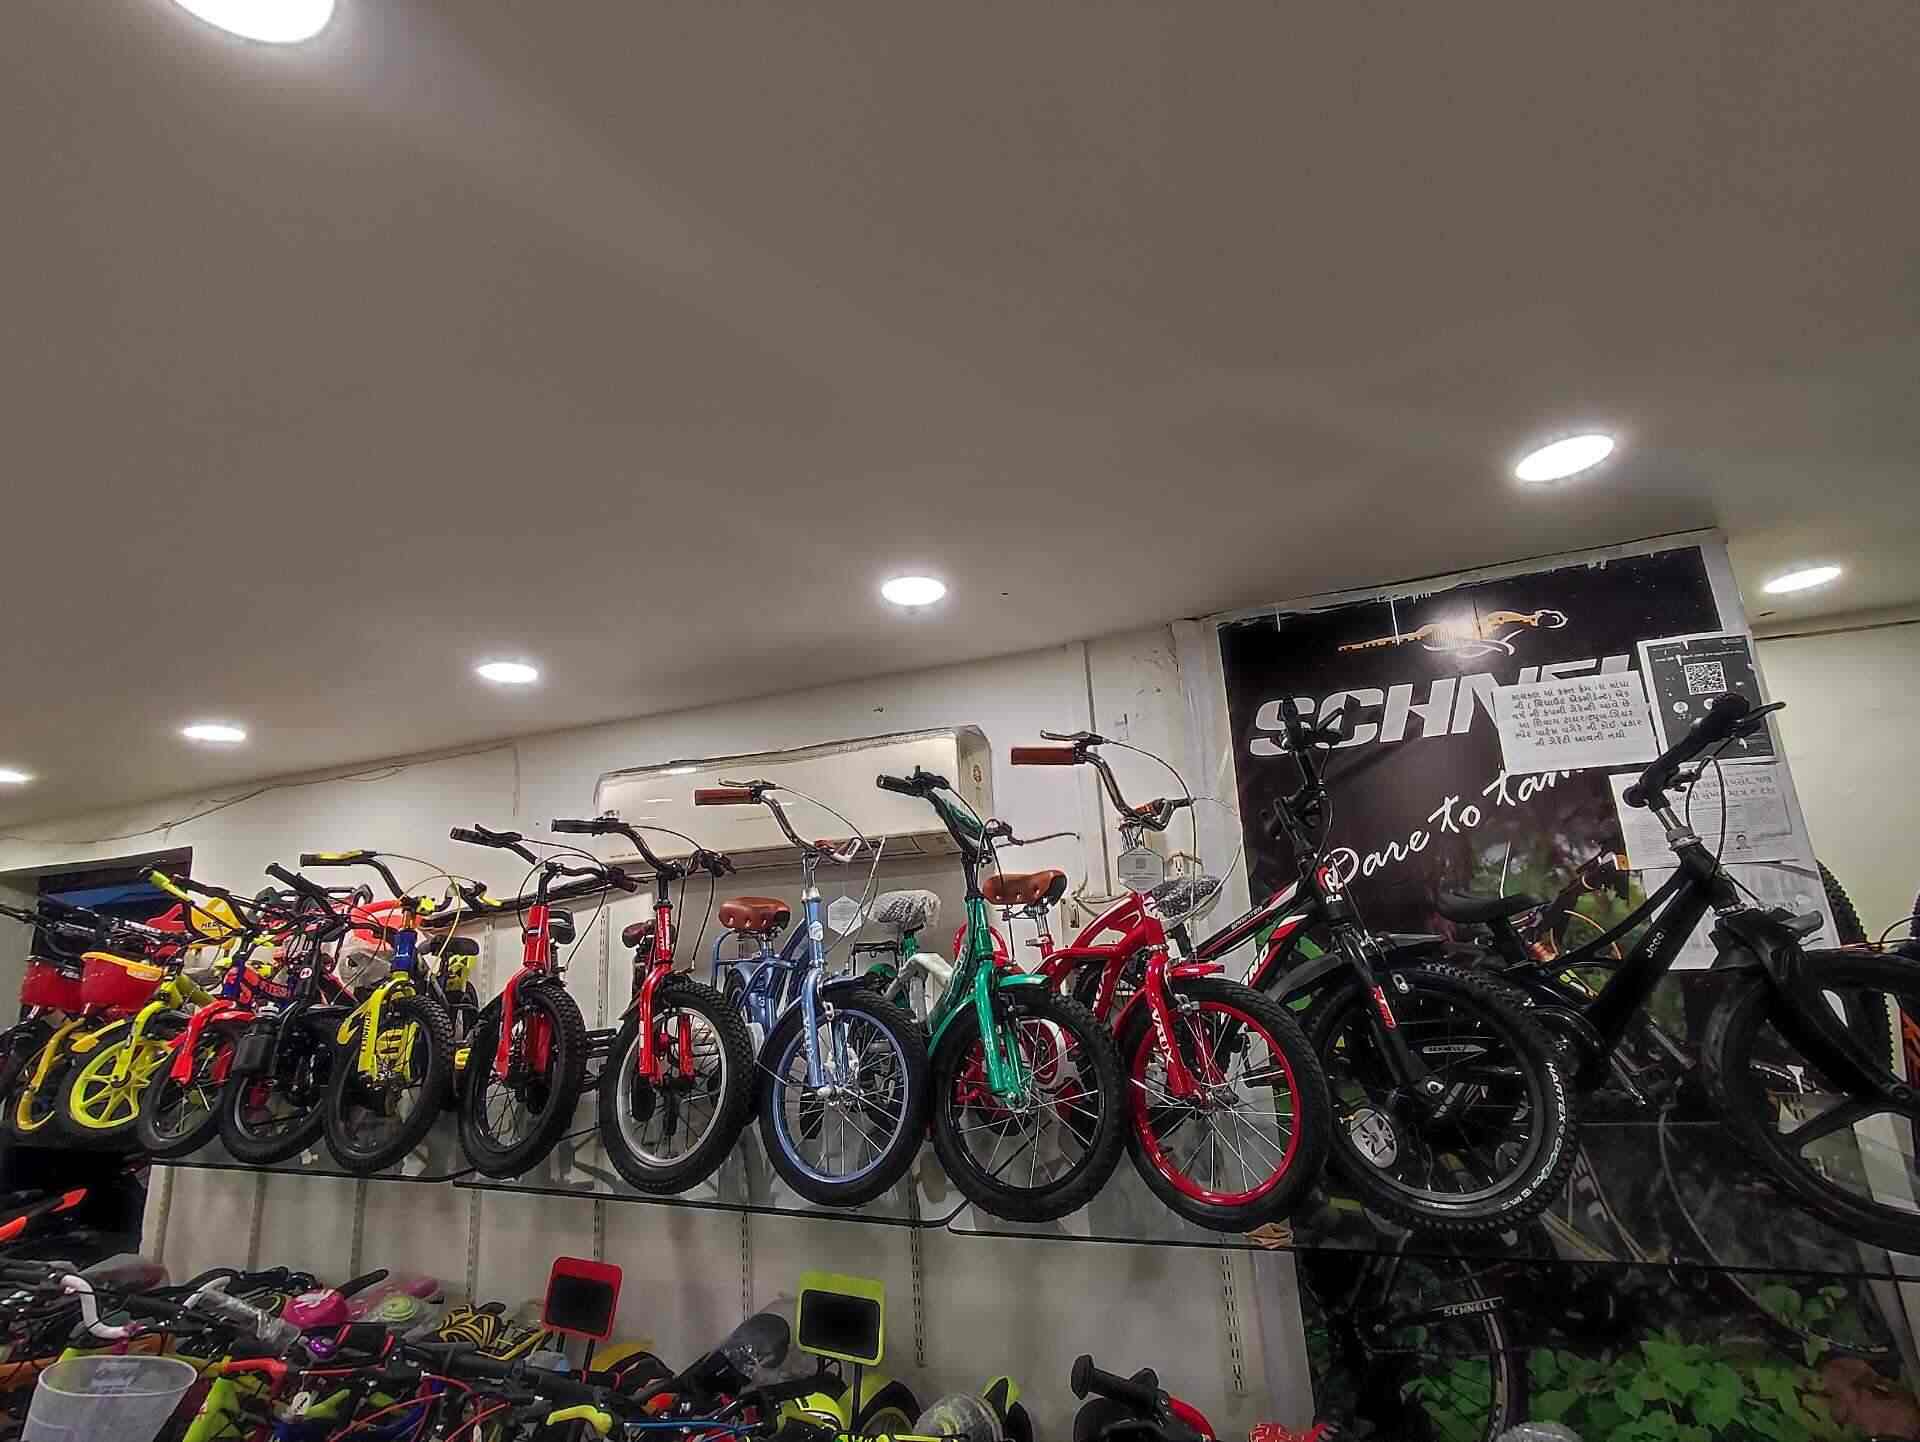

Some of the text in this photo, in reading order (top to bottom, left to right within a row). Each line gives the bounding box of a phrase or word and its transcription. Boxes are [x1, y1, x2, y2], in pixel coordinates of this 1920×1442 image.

[1250, 654, 1629, 757] SCHN
[1428, 794, 1481, 833] to
[1482, 768, 1585, 806] ta
